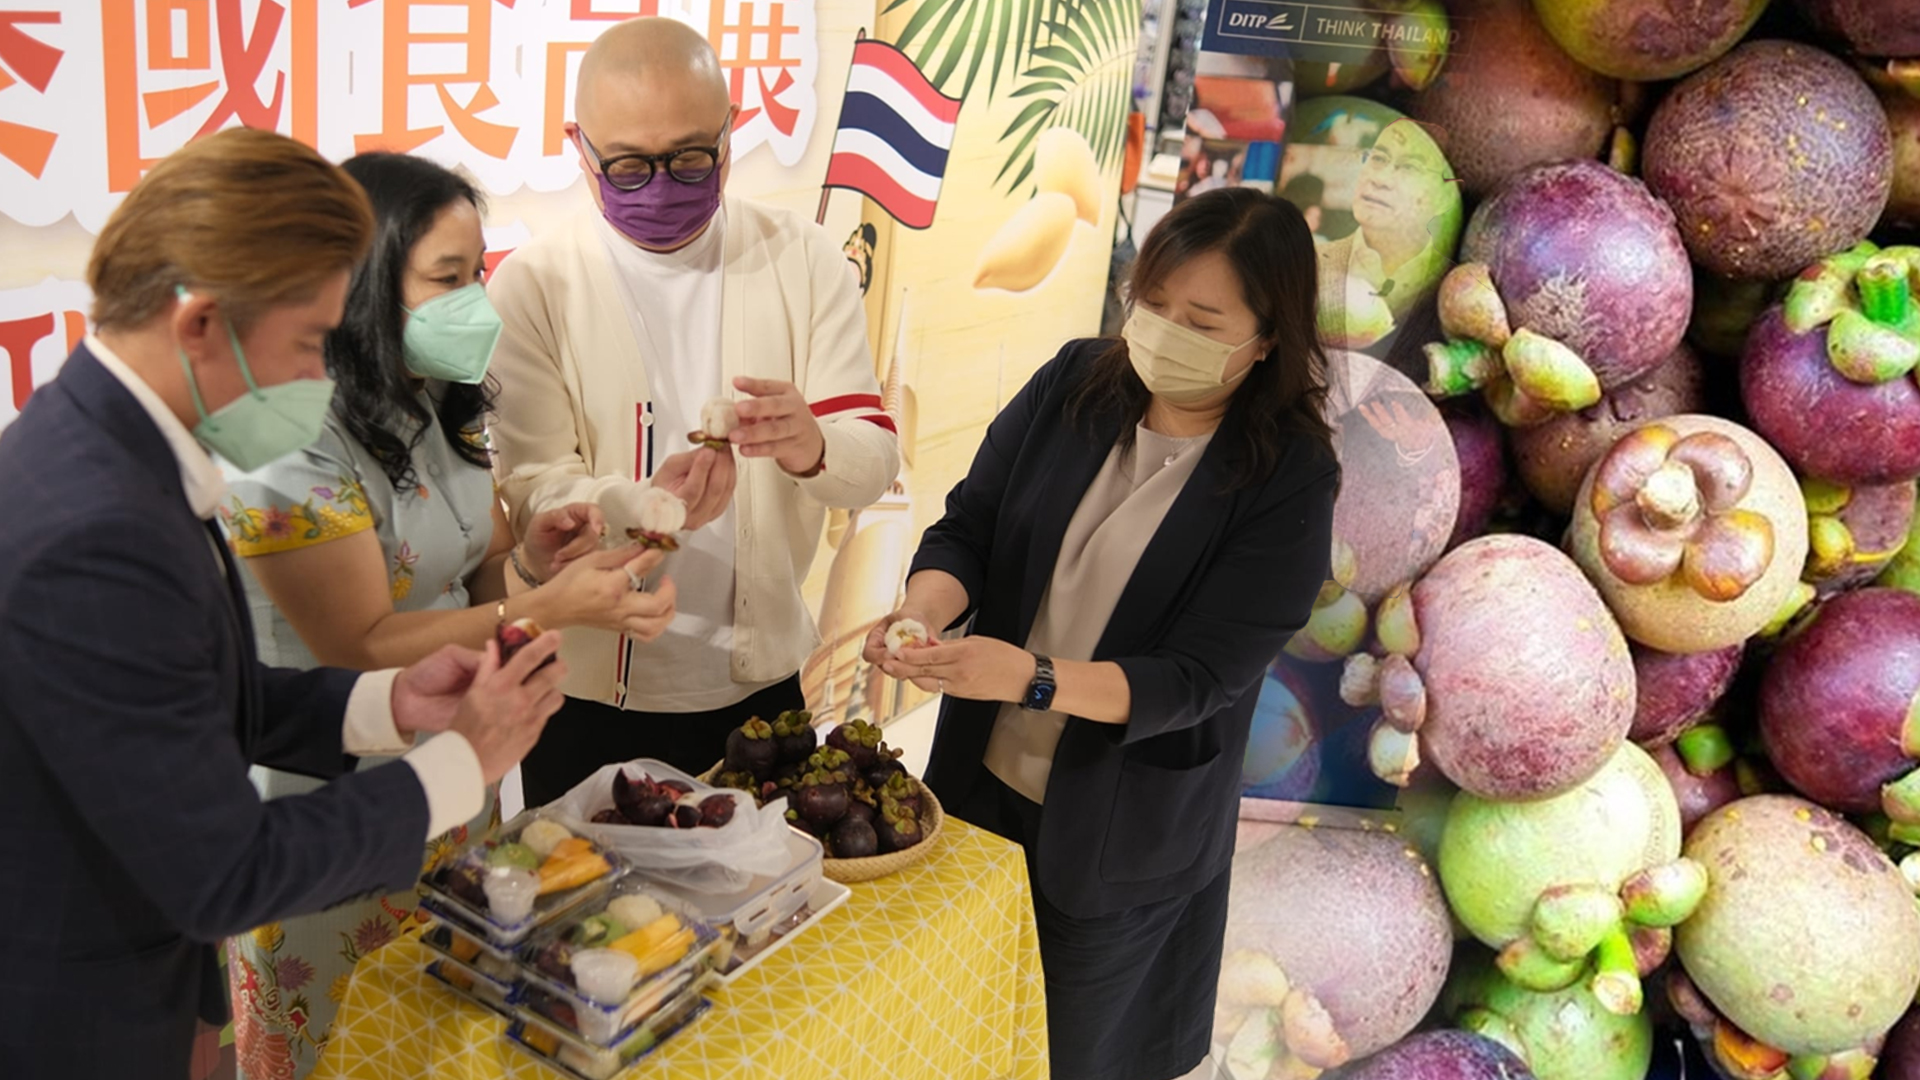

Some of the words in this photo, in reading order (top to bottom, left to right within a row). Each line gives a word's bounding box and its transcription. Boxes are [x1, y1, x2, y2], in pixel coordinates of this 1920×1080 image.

[1228, 12, 1267, 29] DITP
[1316, 17, 1367, 38] THINK
[1371, 22, 1460, 45] THAILAND
